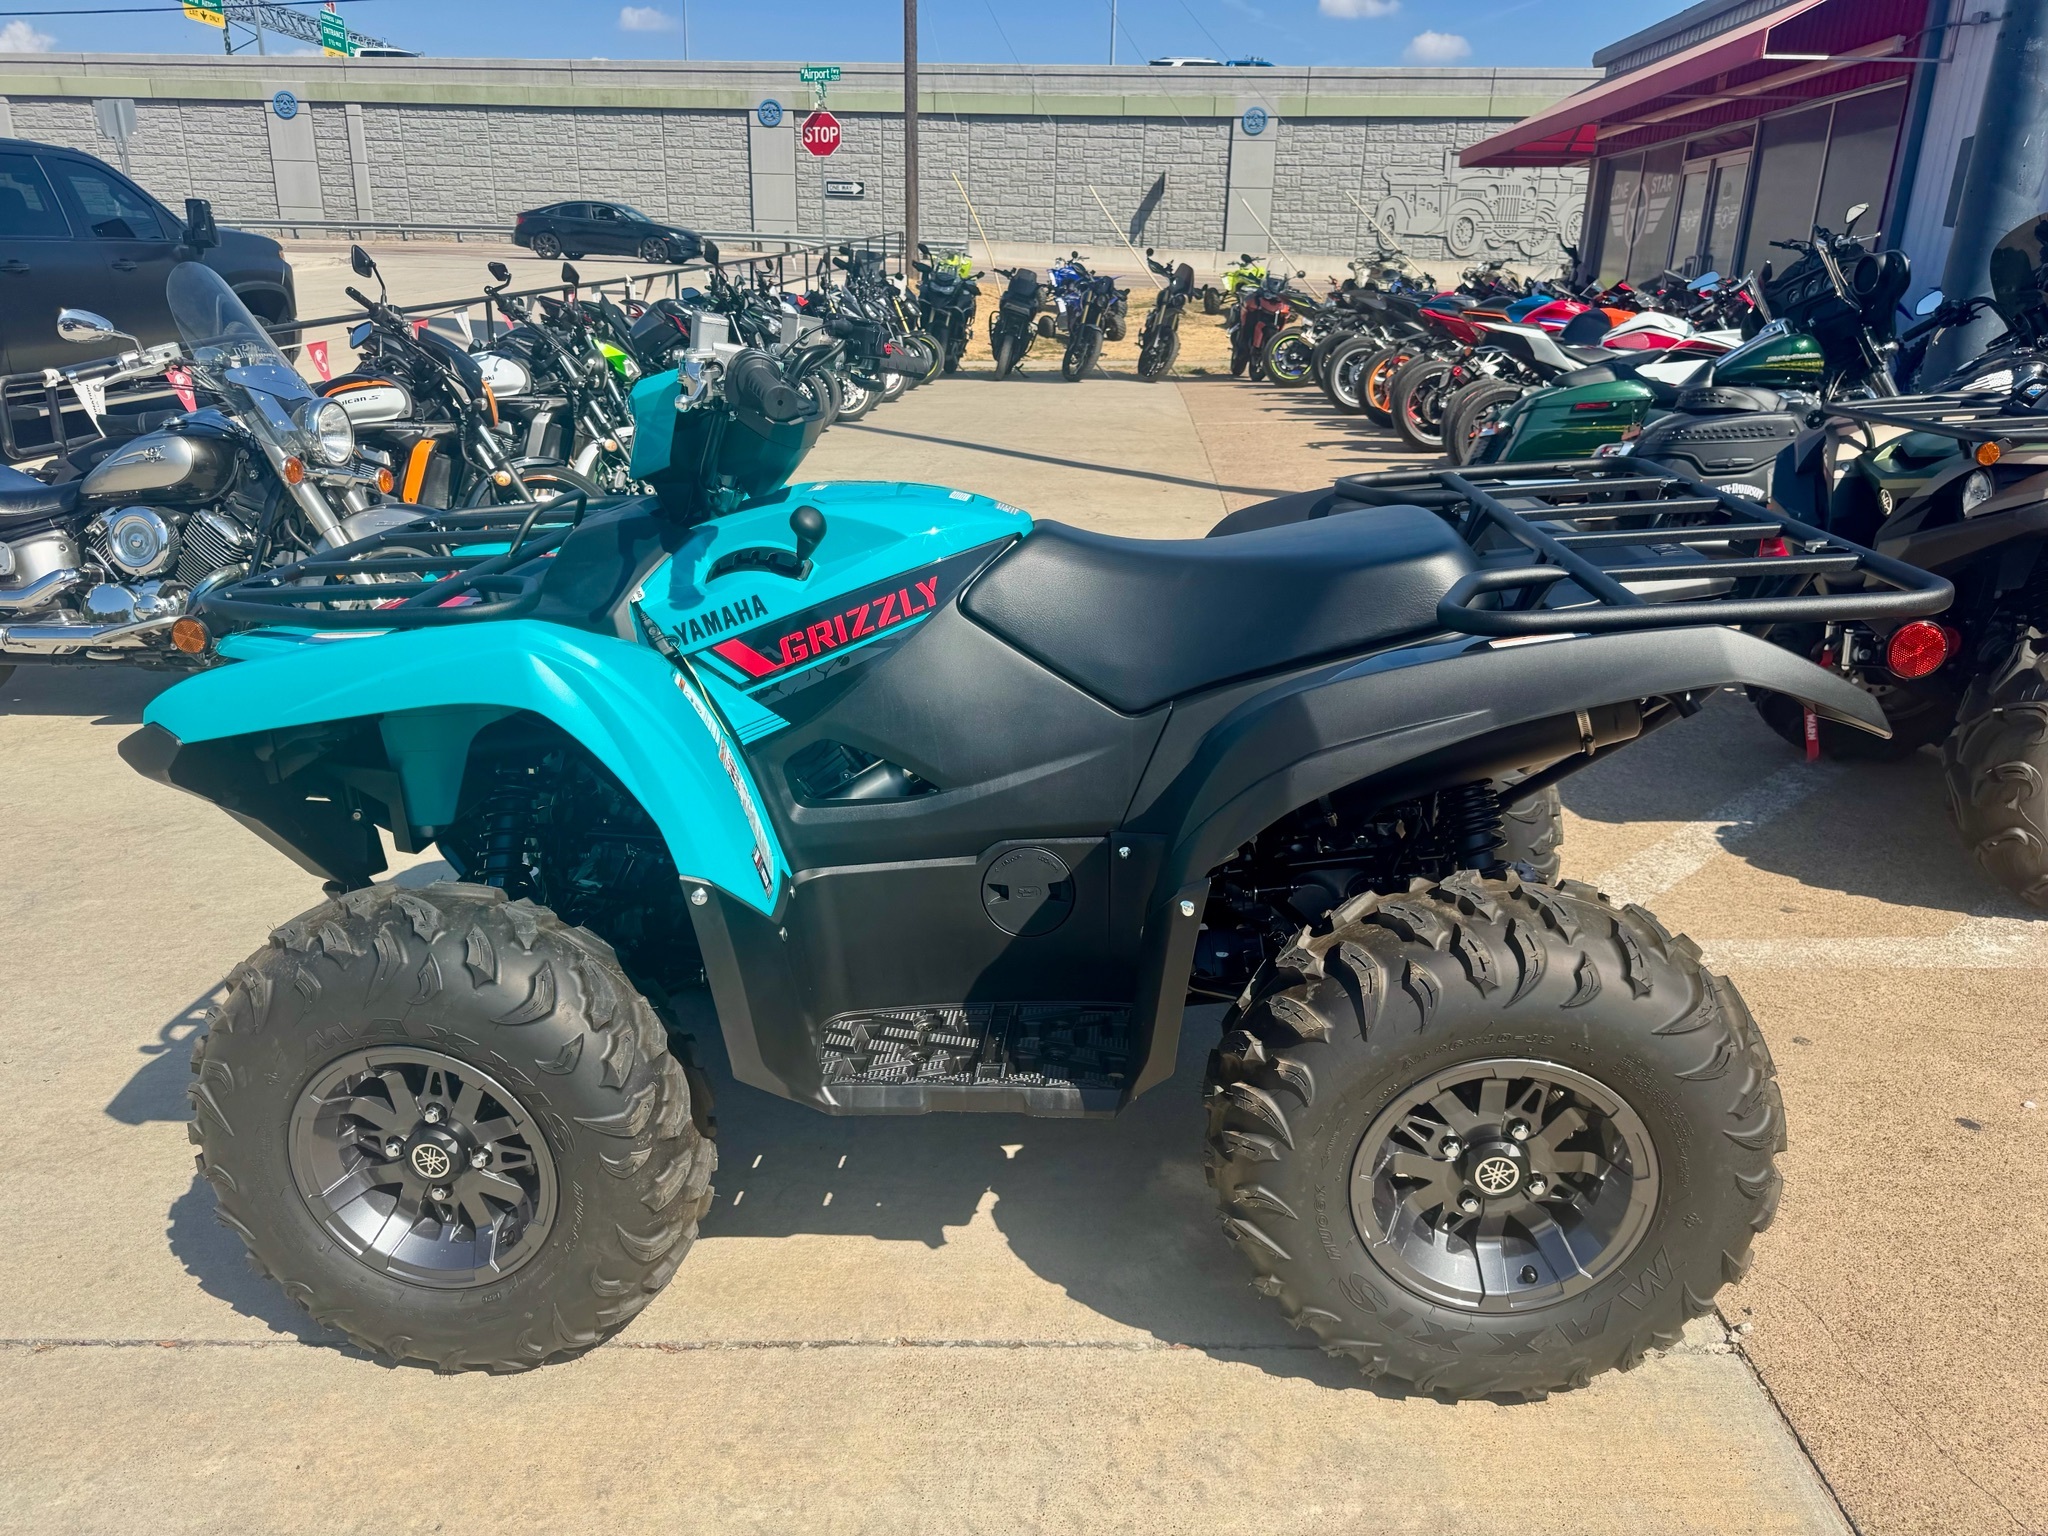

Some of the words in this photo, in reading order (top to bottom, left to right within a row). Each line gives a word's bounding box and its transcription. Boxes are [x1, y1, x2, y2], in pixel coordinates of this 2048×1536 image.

[323, 26, 345, 40] ENTRANCE
[803, 68, 830, 81] Airport
[831, 67, 840, 75] Fwy
[804, 126, 839, 143] STOP
[1651, 173, 1674, 195] STAR
[340, 396, 367, 407] ulcan
[1716, 482, 1765, 501] EY-DAVIDSON
[672, 594, 769, 646] YAMAHA
[778, 575, 938, 666] GRIZZLY
[1807, 713, 1817, 741] WARN
[303, 1018, 576, 1153] MAXXIS
[1338, 1244, 1678, 1357] MAXXIS
